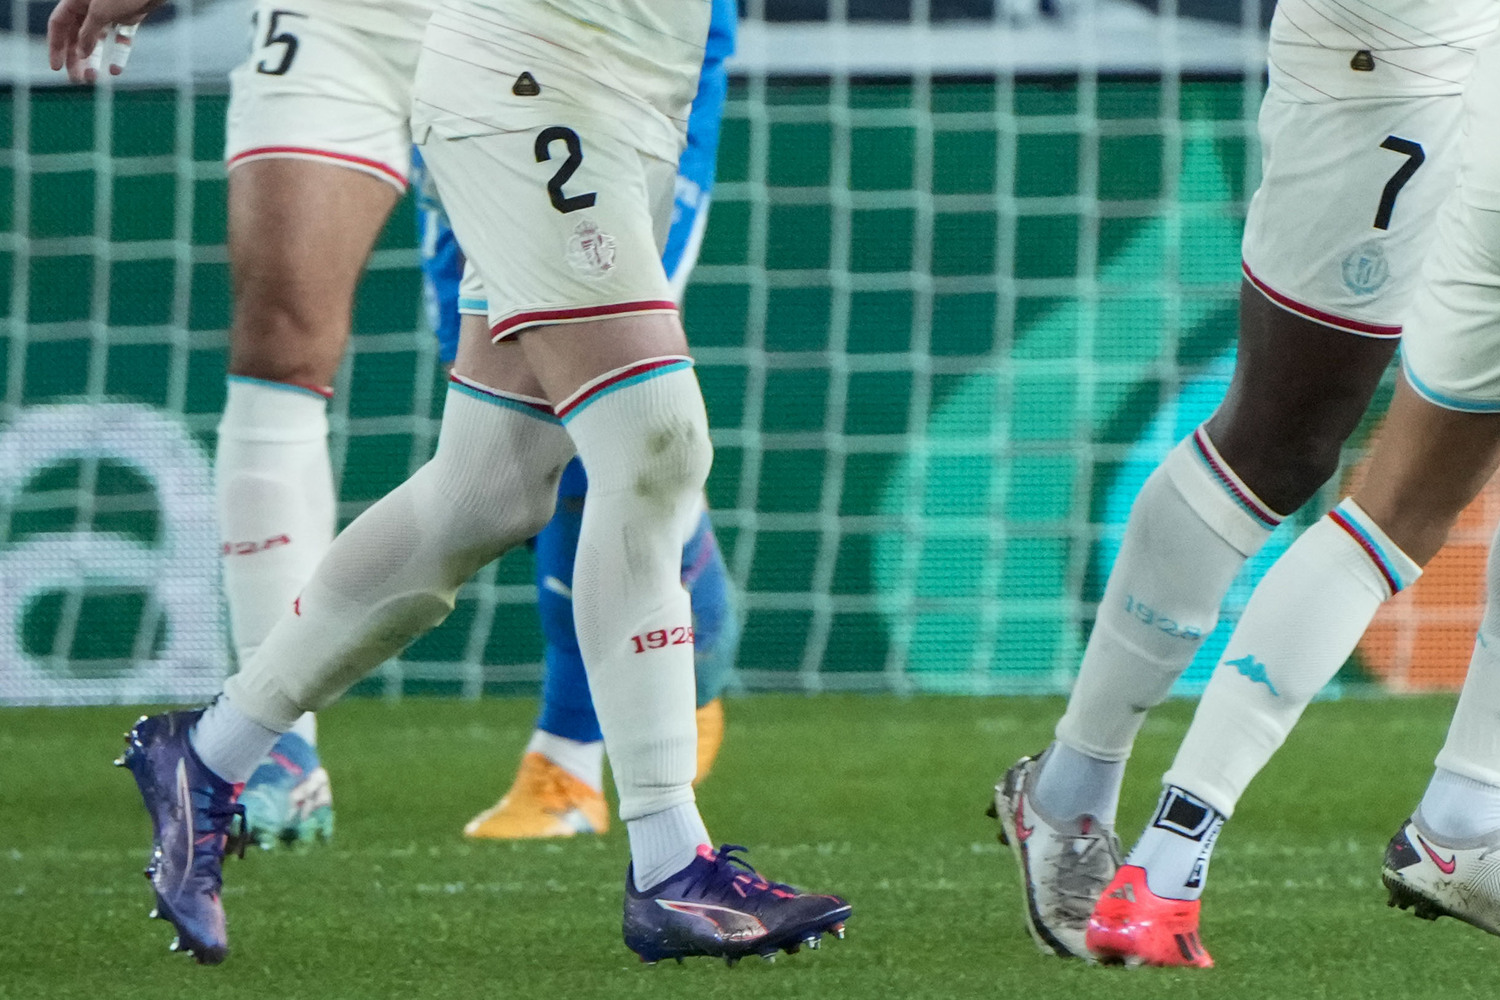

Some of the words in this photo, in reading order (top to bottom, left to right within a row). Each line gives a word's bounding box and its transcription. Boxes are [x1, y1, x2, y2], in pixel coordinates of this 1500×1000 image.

[243, 9, 309, 76] 5
[534, 126, 597, 214] 2
[1373, 134, 1426, 231] 7
[1124, 595, 1202, 641] 1928
